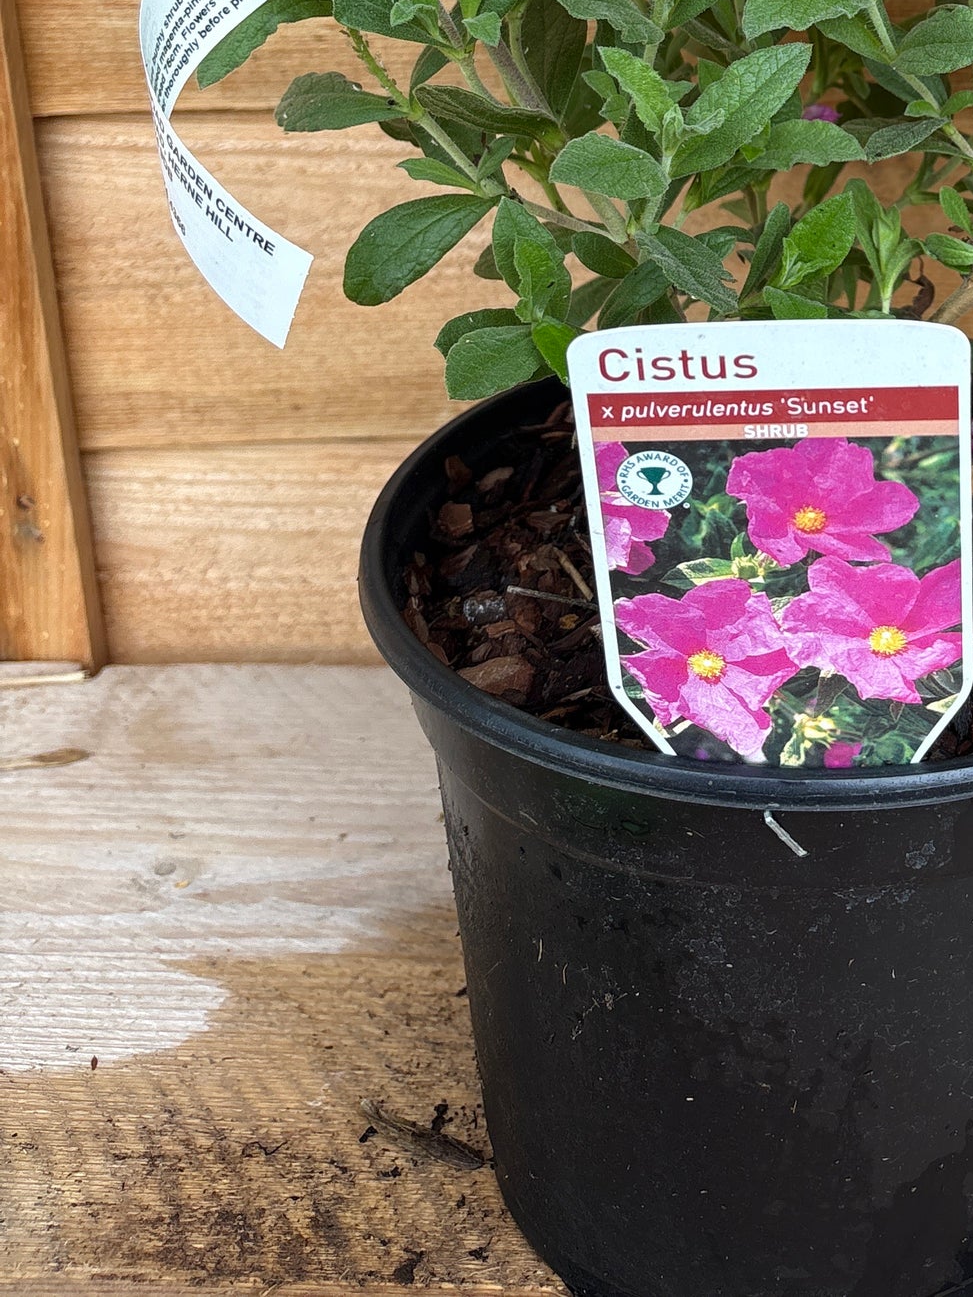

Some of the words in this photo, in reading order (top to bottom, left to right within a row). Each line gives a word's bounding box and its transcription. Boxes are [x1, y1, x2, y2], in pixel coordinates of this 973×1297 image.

[164, 38, 200, 99] thoroughly
[198, 6, 231, 39] before
[166, 133, 213, 201] GARDEN
[215, 198, 275, 256] CENTRE
[168, 151, 203, 209] HERNE
[205, 205, 234, 243] HILL
[598, 347, 758, 382] Cistus
[602, 406, 614, 419] x
[621, 400, 774, 422] pulverulentus
[780, 395, 875, 415] 'Sunset'
[743, 423, 809, 439] SHRUB
[619, 460, 636, 479] RHS
[636, 453, 678, 467] AWARD
[676, 465, 690, 478] OF
[621, 485, 660, 508] GARDEN
[662, 483, 690, 507] MERIT
